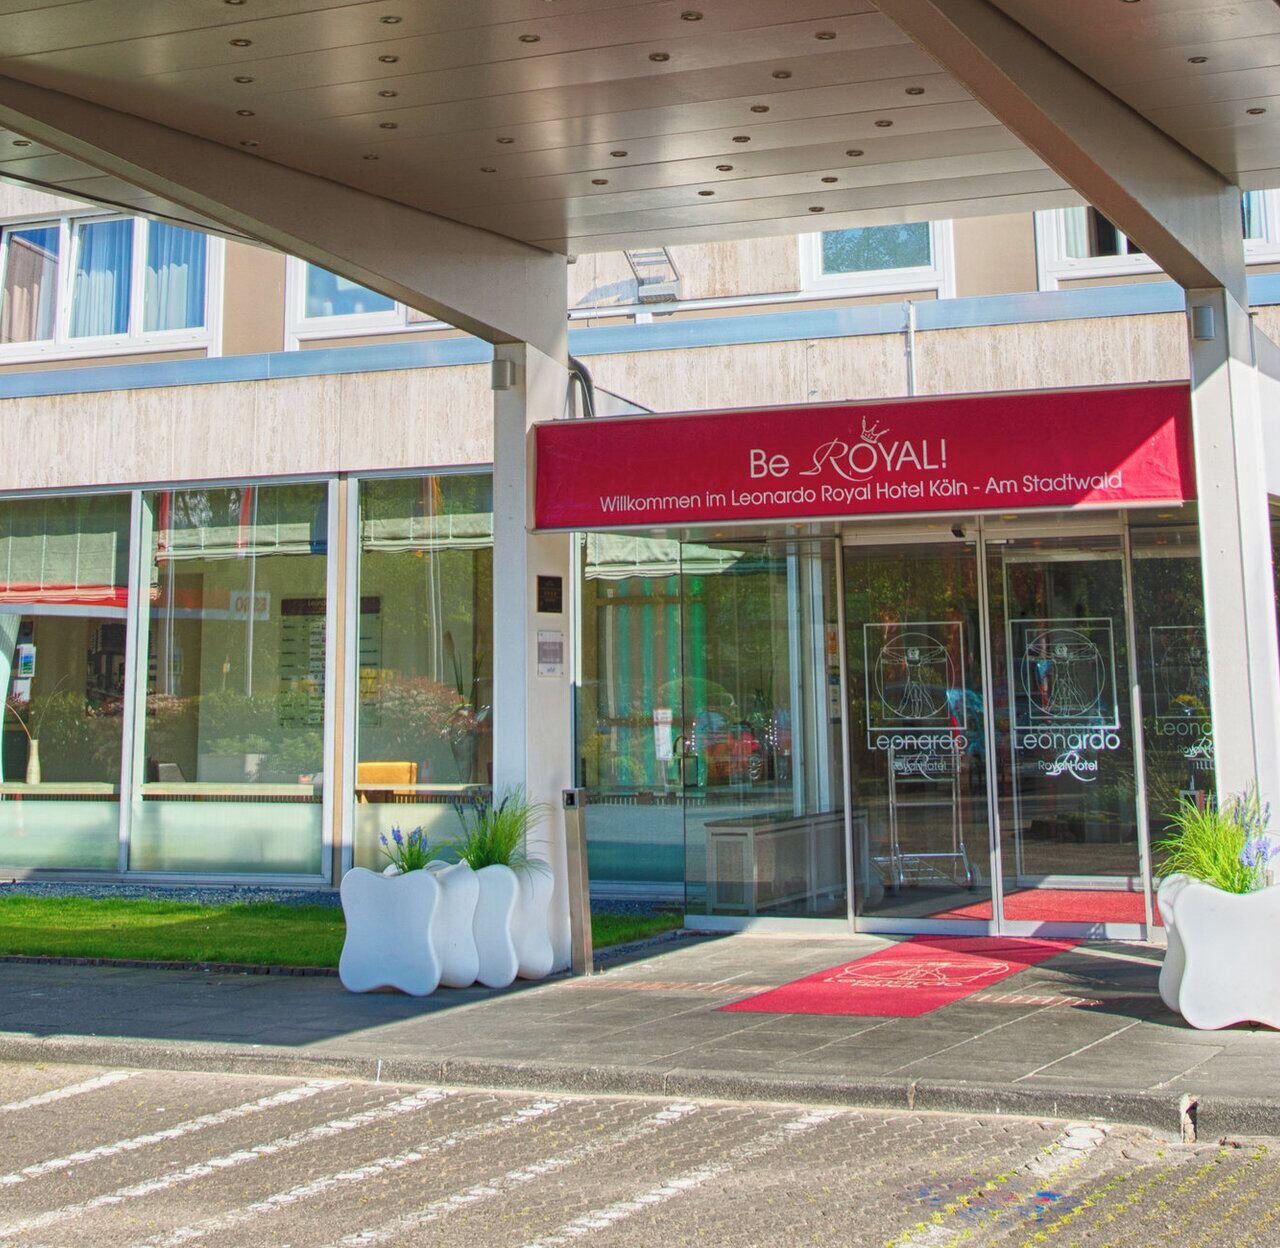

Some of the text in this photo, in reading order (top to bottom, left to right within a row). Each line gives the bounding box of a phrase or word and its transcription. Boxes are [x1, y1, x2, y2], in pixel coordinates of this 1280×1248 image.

[749, 437, 947, 482] Be ROYAL!
[600, 493, 701, 513] Willkommen
[705, 491, 726, 508] im
[731, 486, 817, 507] Leonardo
[820, 483, 871, 505] Royal
[876, 480, 924, 500] Hotel
[929, 479, 969, 498] Köln
[985, 477, 1018, 495] Am
[1022, 471, 1122, 493] Stadtwald
[867, 730, 968, 750] Leonardo
[1014, 729, 1120, 750] Leonardo
